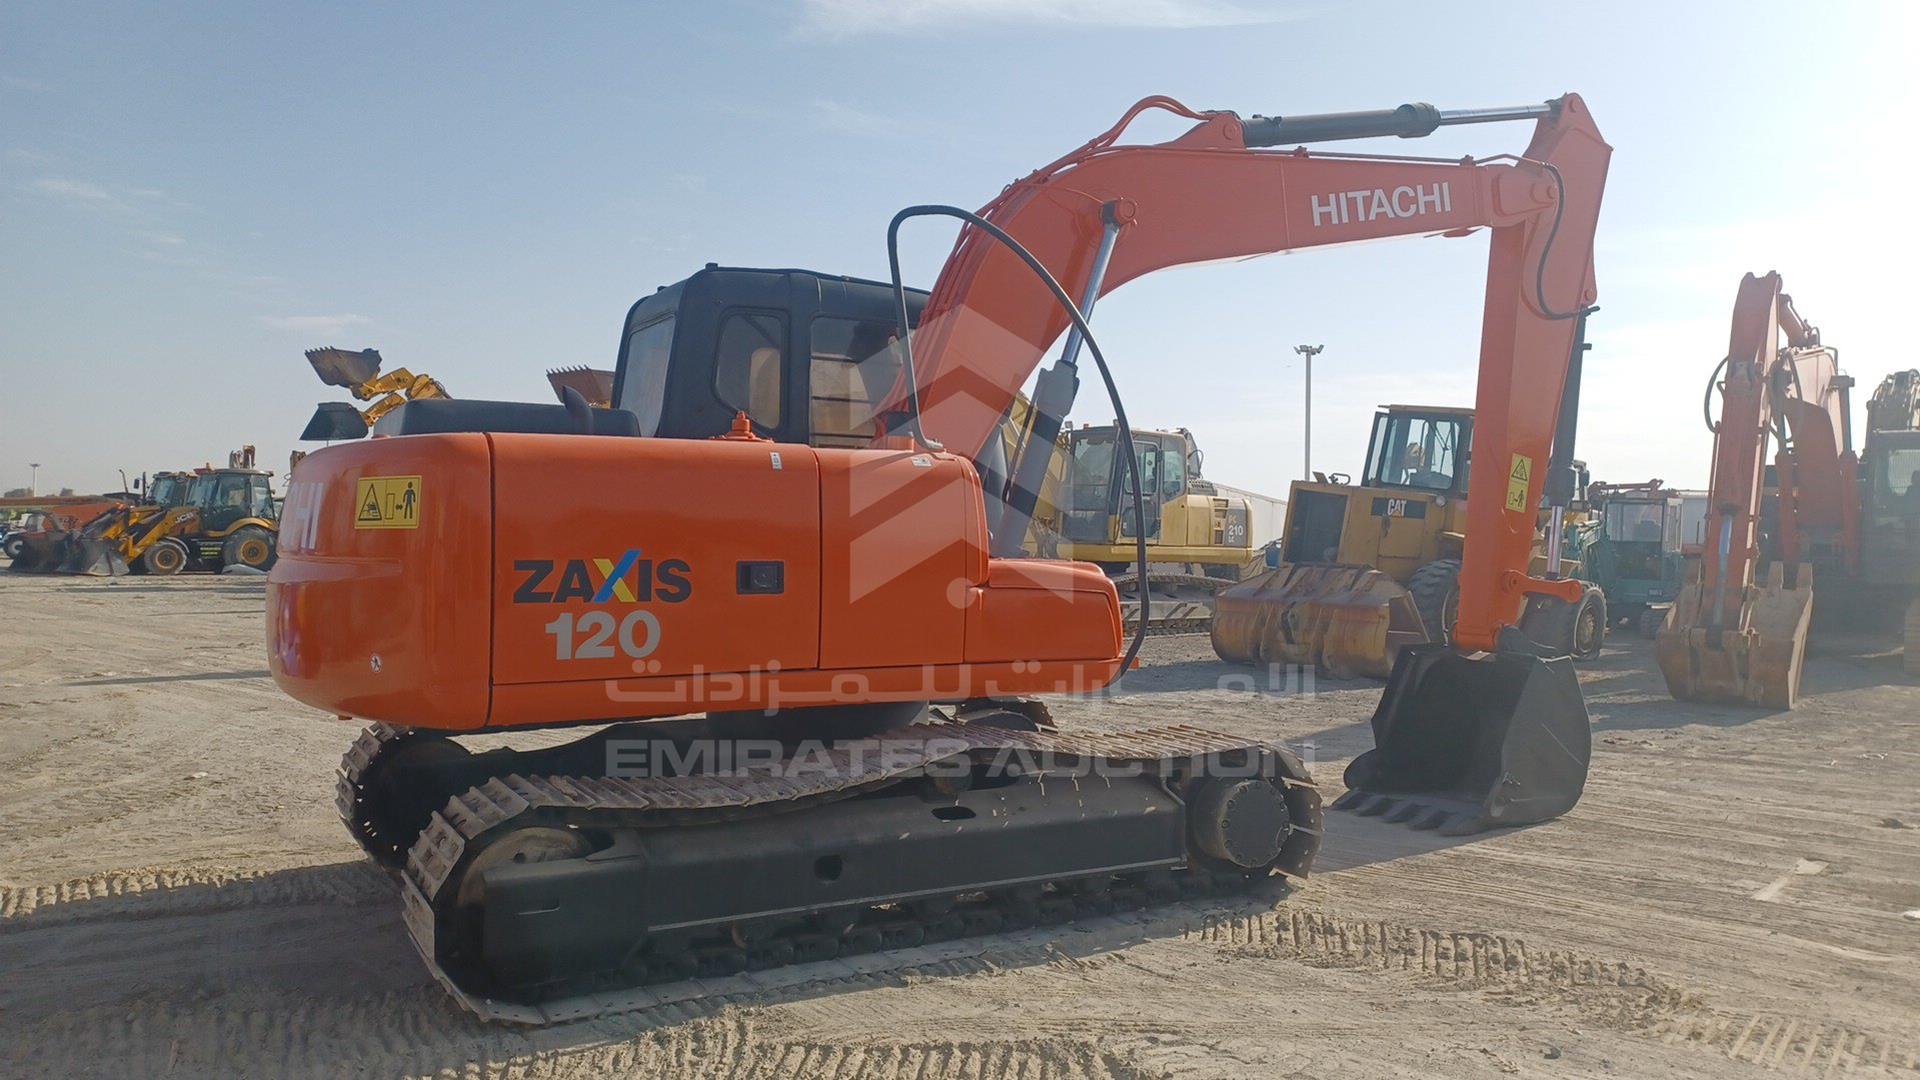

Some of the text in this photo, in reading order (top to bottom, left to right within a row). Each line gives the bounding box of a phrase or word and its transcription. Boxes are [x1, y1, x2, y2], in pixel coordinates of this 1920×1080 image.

[1311, 181, 1452, 226] HITACHI
[1228, 524, 1244, 536] 210
[1387, 498, 1407, 517] CAT
[513, 549, 692, 604] ZAXIS
[545, 609, 662, 661] 120
